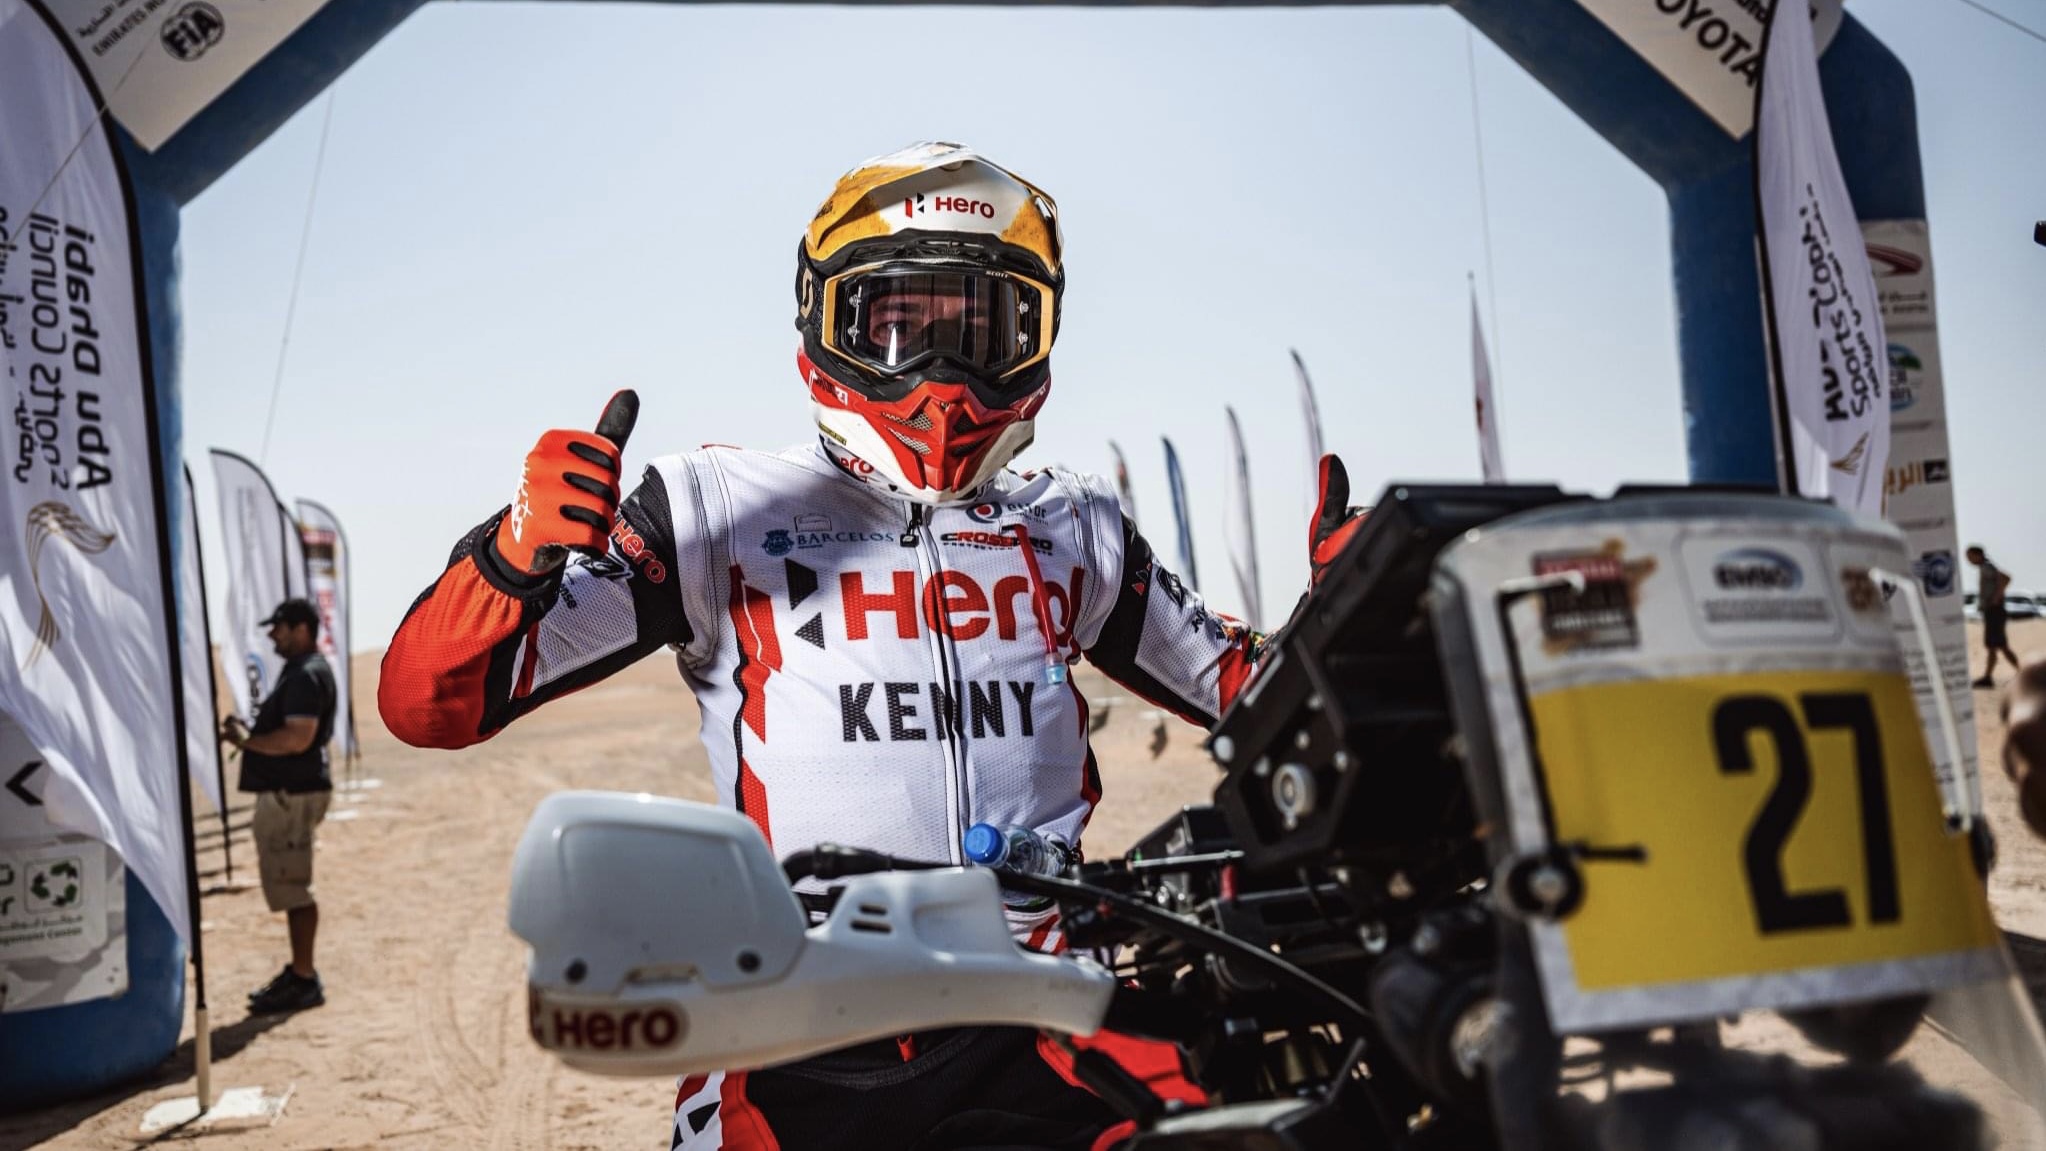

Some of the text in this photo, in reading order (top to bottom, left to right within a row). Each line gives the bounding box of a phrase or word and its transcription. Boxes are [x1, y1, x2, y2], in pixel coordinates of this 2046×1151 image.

[1655, 0, 1763, 88] OYOTA
[935, 196, 995, 219] Hero
[985, 270, 1009, 279] SCOTT
[840, 456, 875, 475] ero
[611, 519, 667, 585] Hero
[797, 531, 895, 546] BARCELOS
[839, 570, 1078, 648] Hero
[839, 680, 1035, 742] KENNY
[1710, 692, 1902, 937] 27
[553, 1006, 680, 1050] Hero
